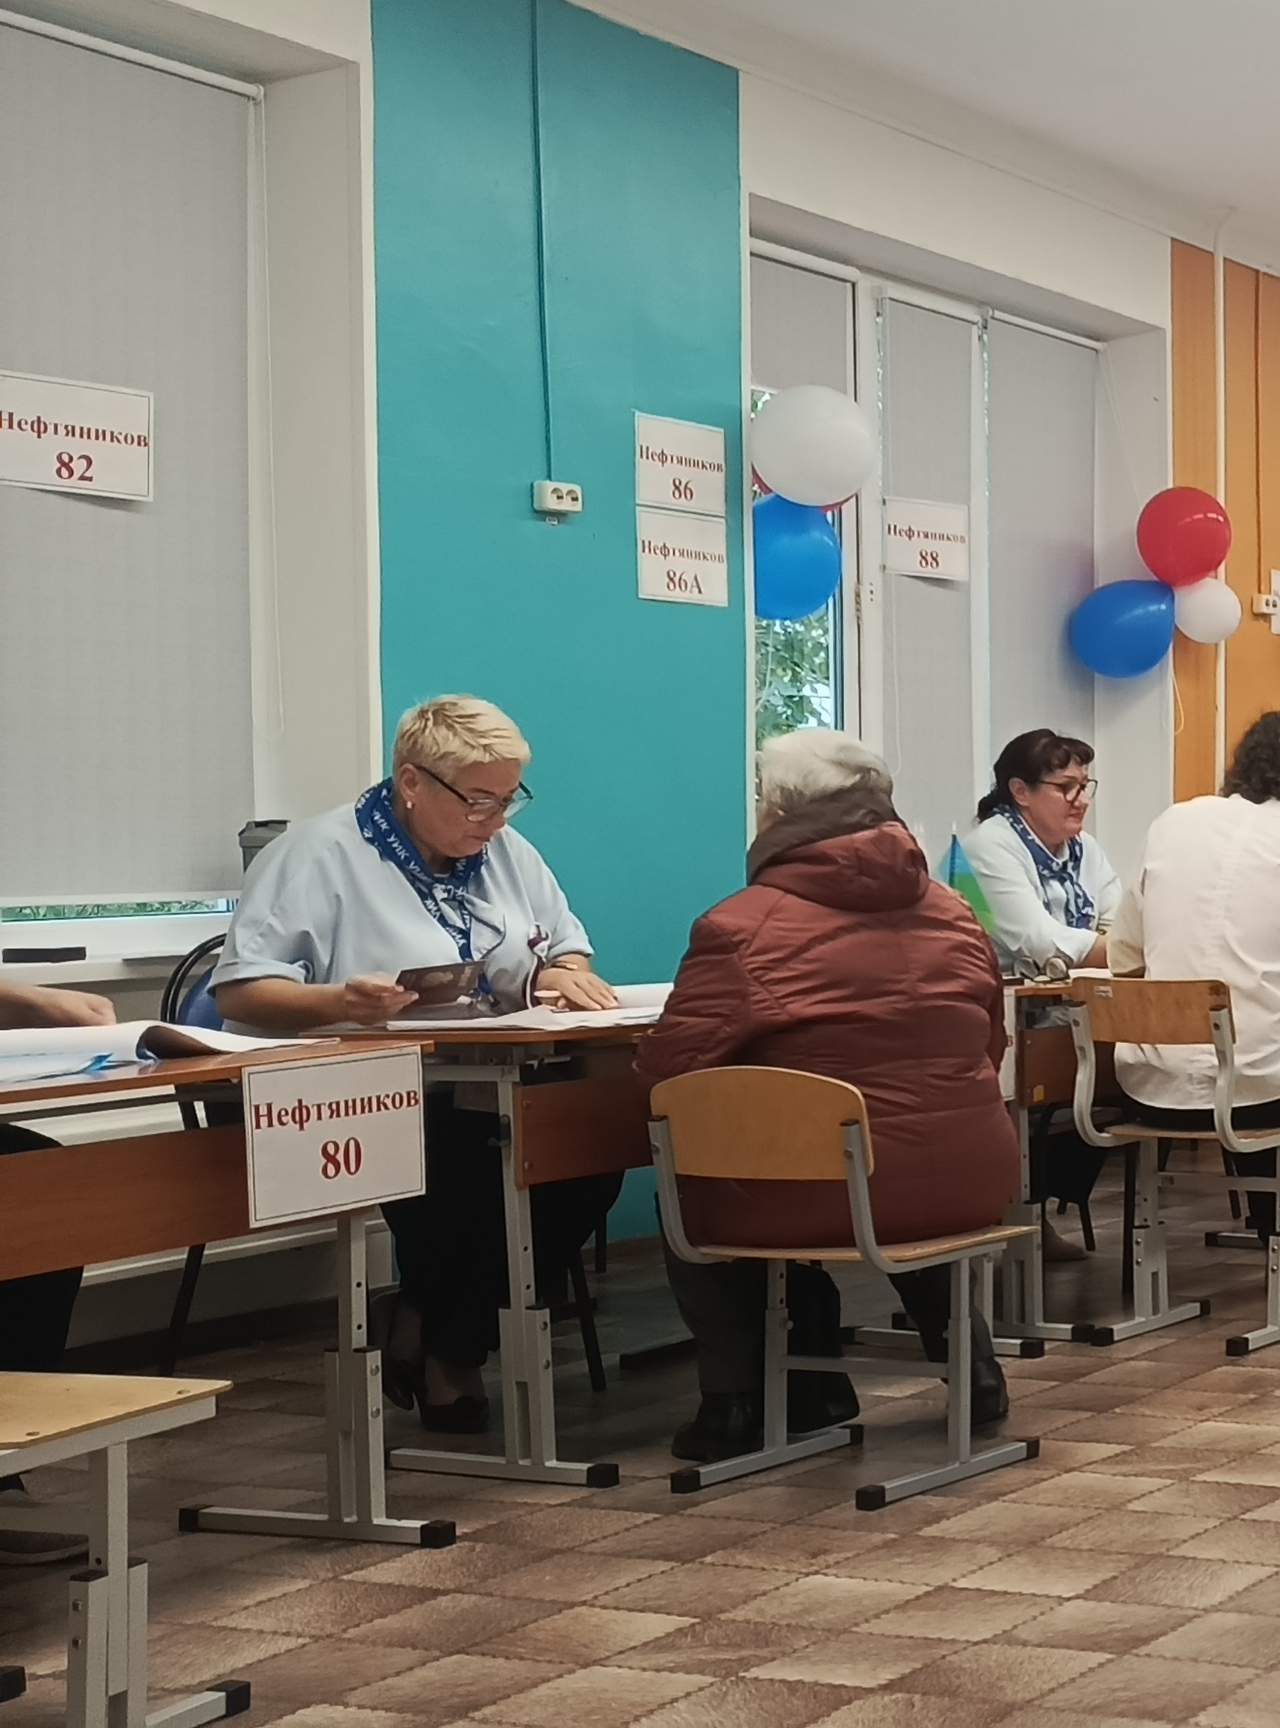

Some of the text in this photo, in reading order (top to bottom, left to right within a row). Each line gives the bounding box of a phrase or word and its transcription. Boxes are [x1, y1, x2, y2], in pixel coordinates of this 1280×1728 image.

[0, 410, 149, 447] Нефтяников
[55, 451, 94, 482] 82
[639, 444, 724, 473] Нефтяников
[671, 477, 694, 501] 86
[887, 523, 967, 544] Нефтяников
[641, 539, 725, 564] Нефтяников
[919, 548, 940, 570] 88
[253, 1089, 420, 1131] Нефтяников
[320, 1136, 363, 1180] 80
